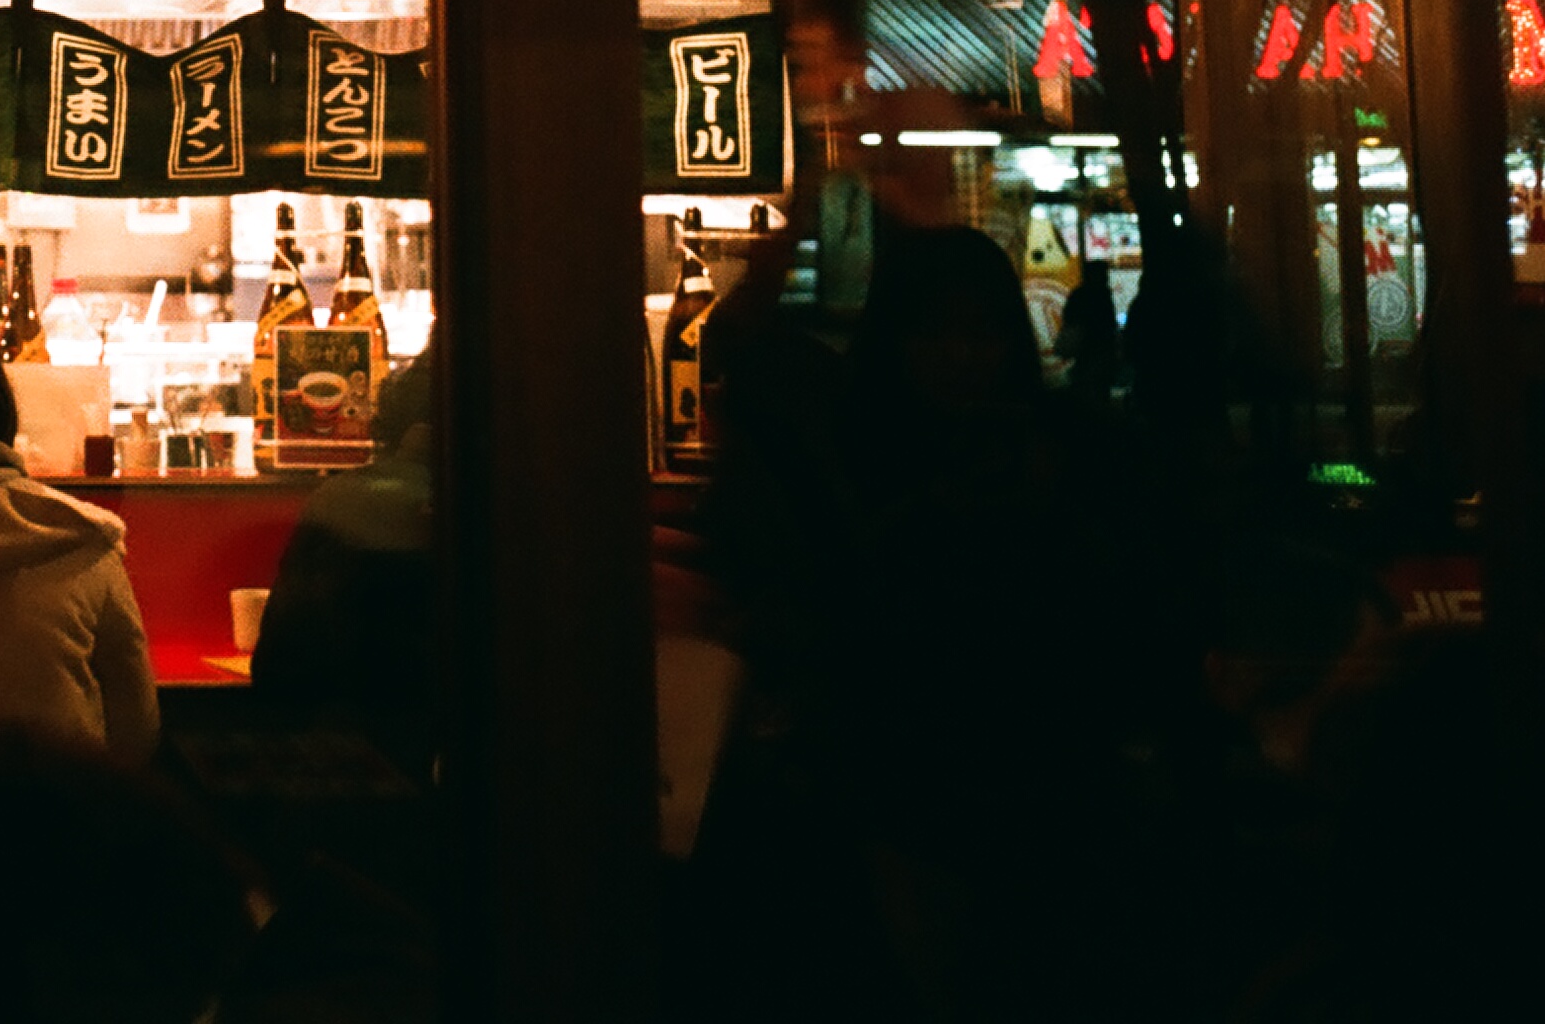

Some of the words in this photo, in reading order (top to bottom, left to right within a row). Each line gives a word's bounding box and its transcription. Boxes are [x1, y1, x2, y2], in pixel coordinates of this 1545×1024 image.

[64, 50, 110, 164] うまい
[185, 54, 225, 165] ラーメン
[320, 46, 371, 162] とんこつ
[689, 46, 738, 162] ビール
